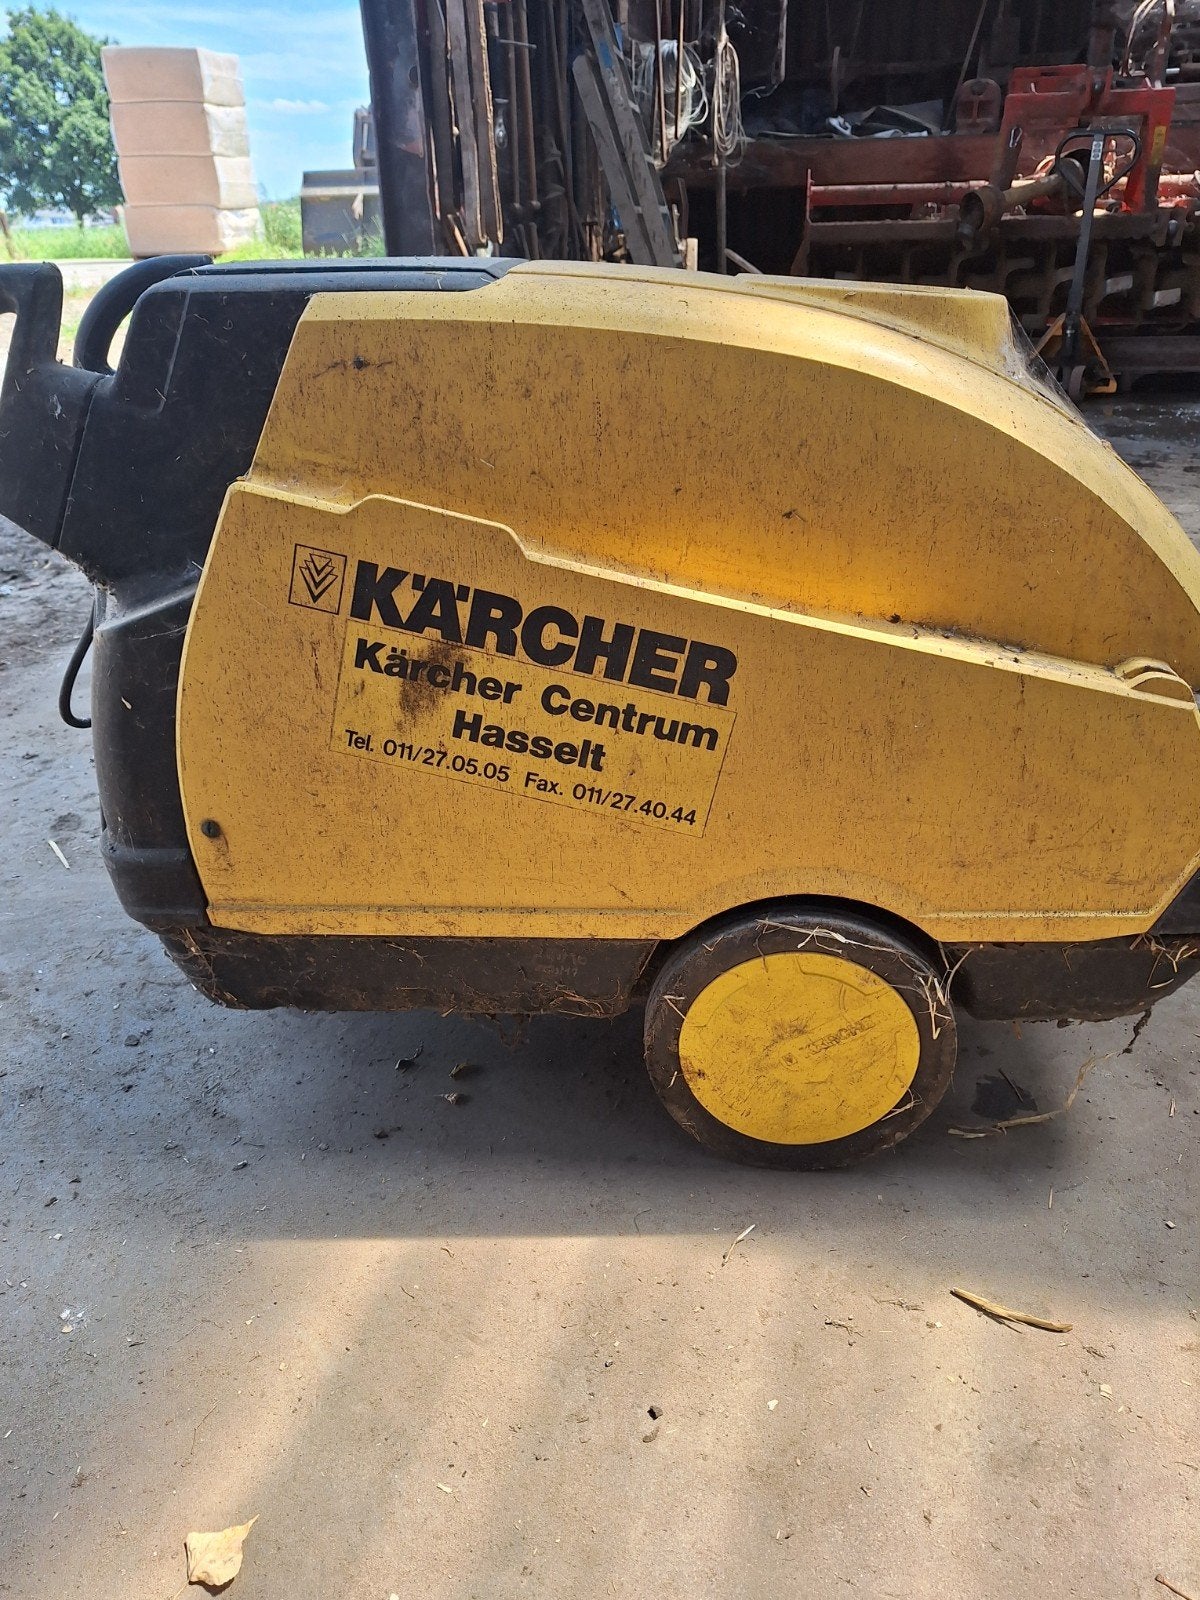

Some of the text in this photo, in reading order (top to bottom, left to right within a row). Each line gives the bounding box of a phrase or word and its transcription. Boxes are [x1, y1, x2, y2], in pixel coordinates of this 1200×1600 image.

[350, 560, 738, 706] KÄRCHER
[354, 638, 719, 751] Kärcher Centrum
[452, 709, 606, 772] Hasselt
[344, 729, 697, 826] Tel. 011/27.05.05 Fax. 011/27.40.44
